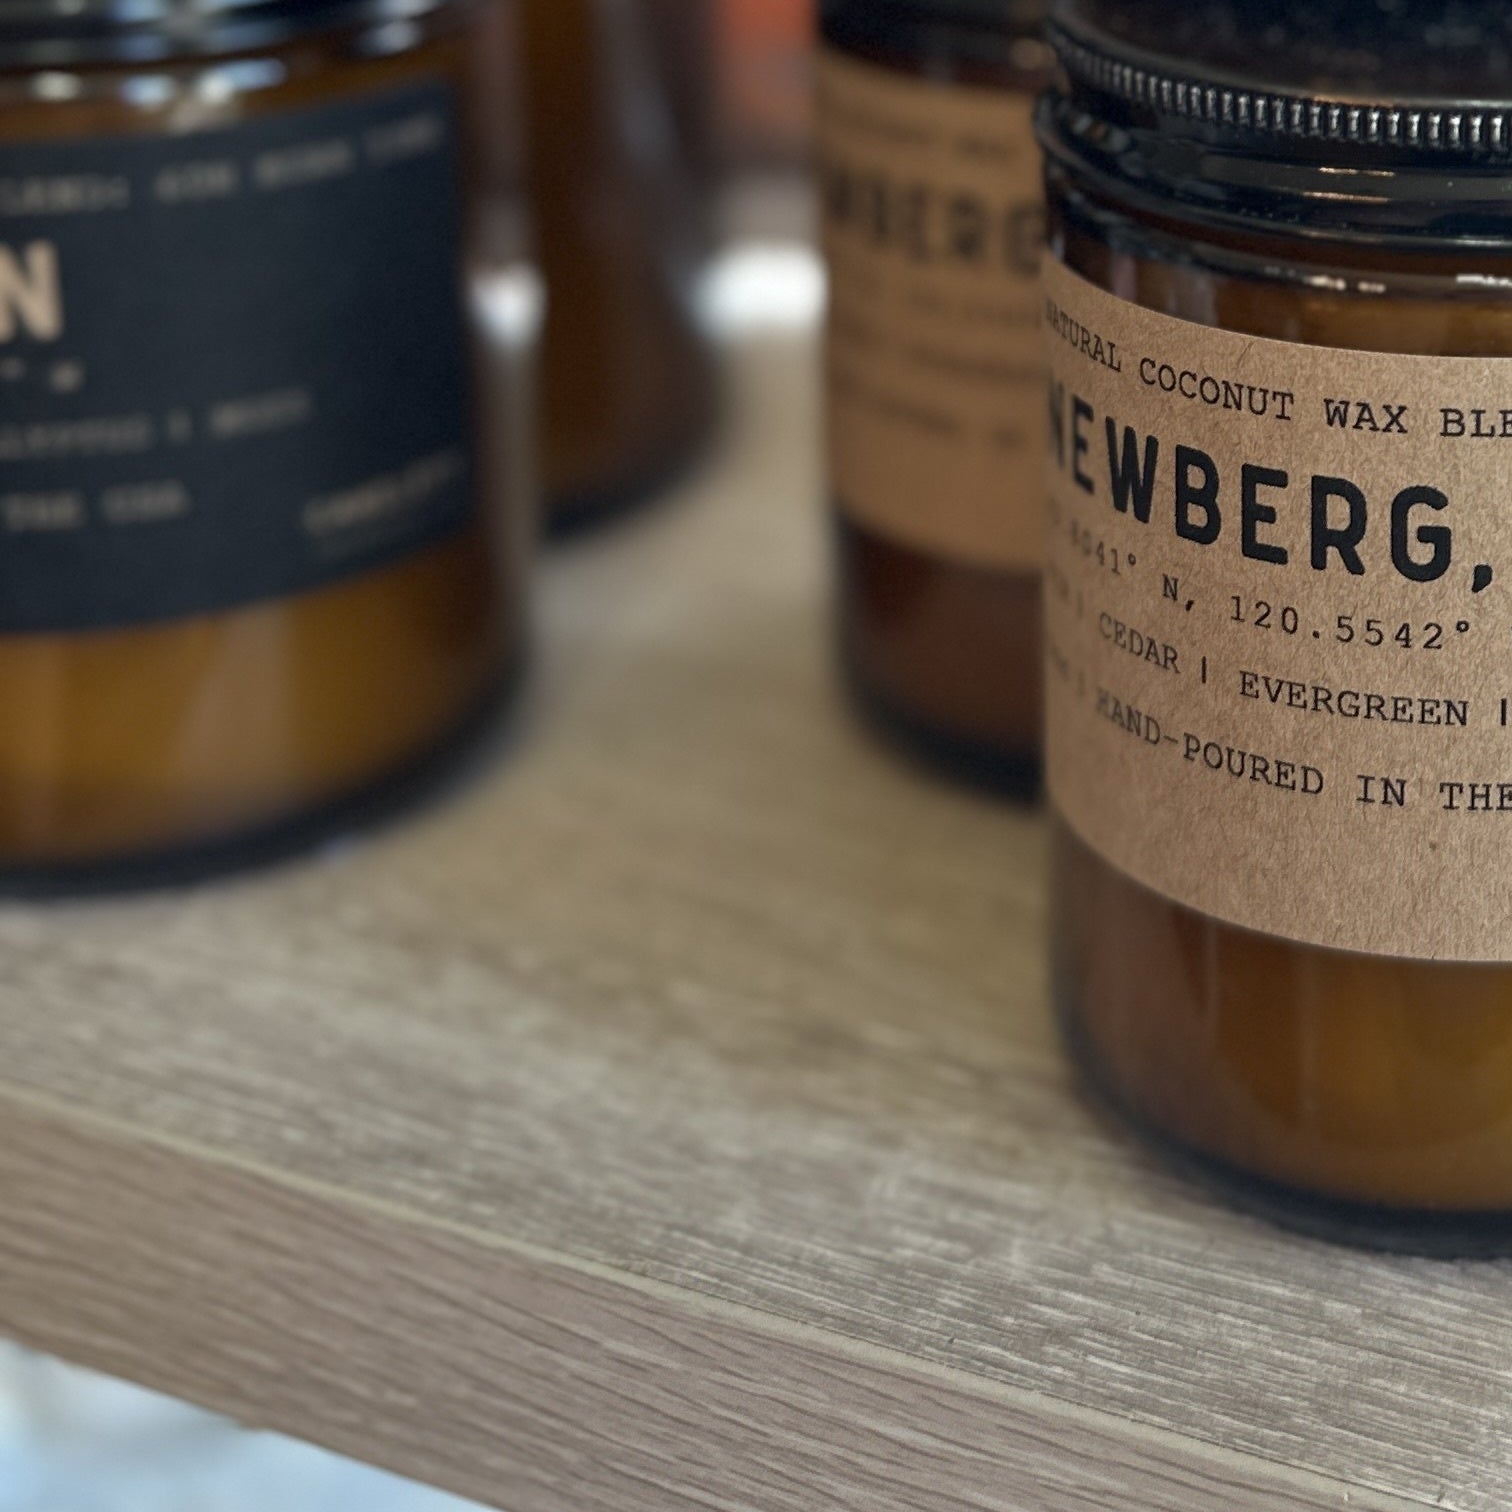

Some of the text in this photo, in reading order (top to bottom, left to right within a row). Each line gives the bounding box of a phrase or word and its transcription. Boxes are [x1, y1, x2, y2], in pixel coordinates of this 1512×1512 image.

[1139, 356, 1295, 421] COCONUT
[1322, 397, 1409, 434] WAX
[1047, 378, 1493, 593] NEWBERG,
[1098, 611, 1181, 675] CEDAR
[1238, 670, 1470, 727] EVERGREEN
[1161, 572, 1195, 613] N,
[1230, 595, 1470, 650] 120.5542°
[1096, 687, 1325, 796] HAND-POURED
[1356, 774, 1408, 807] IN
